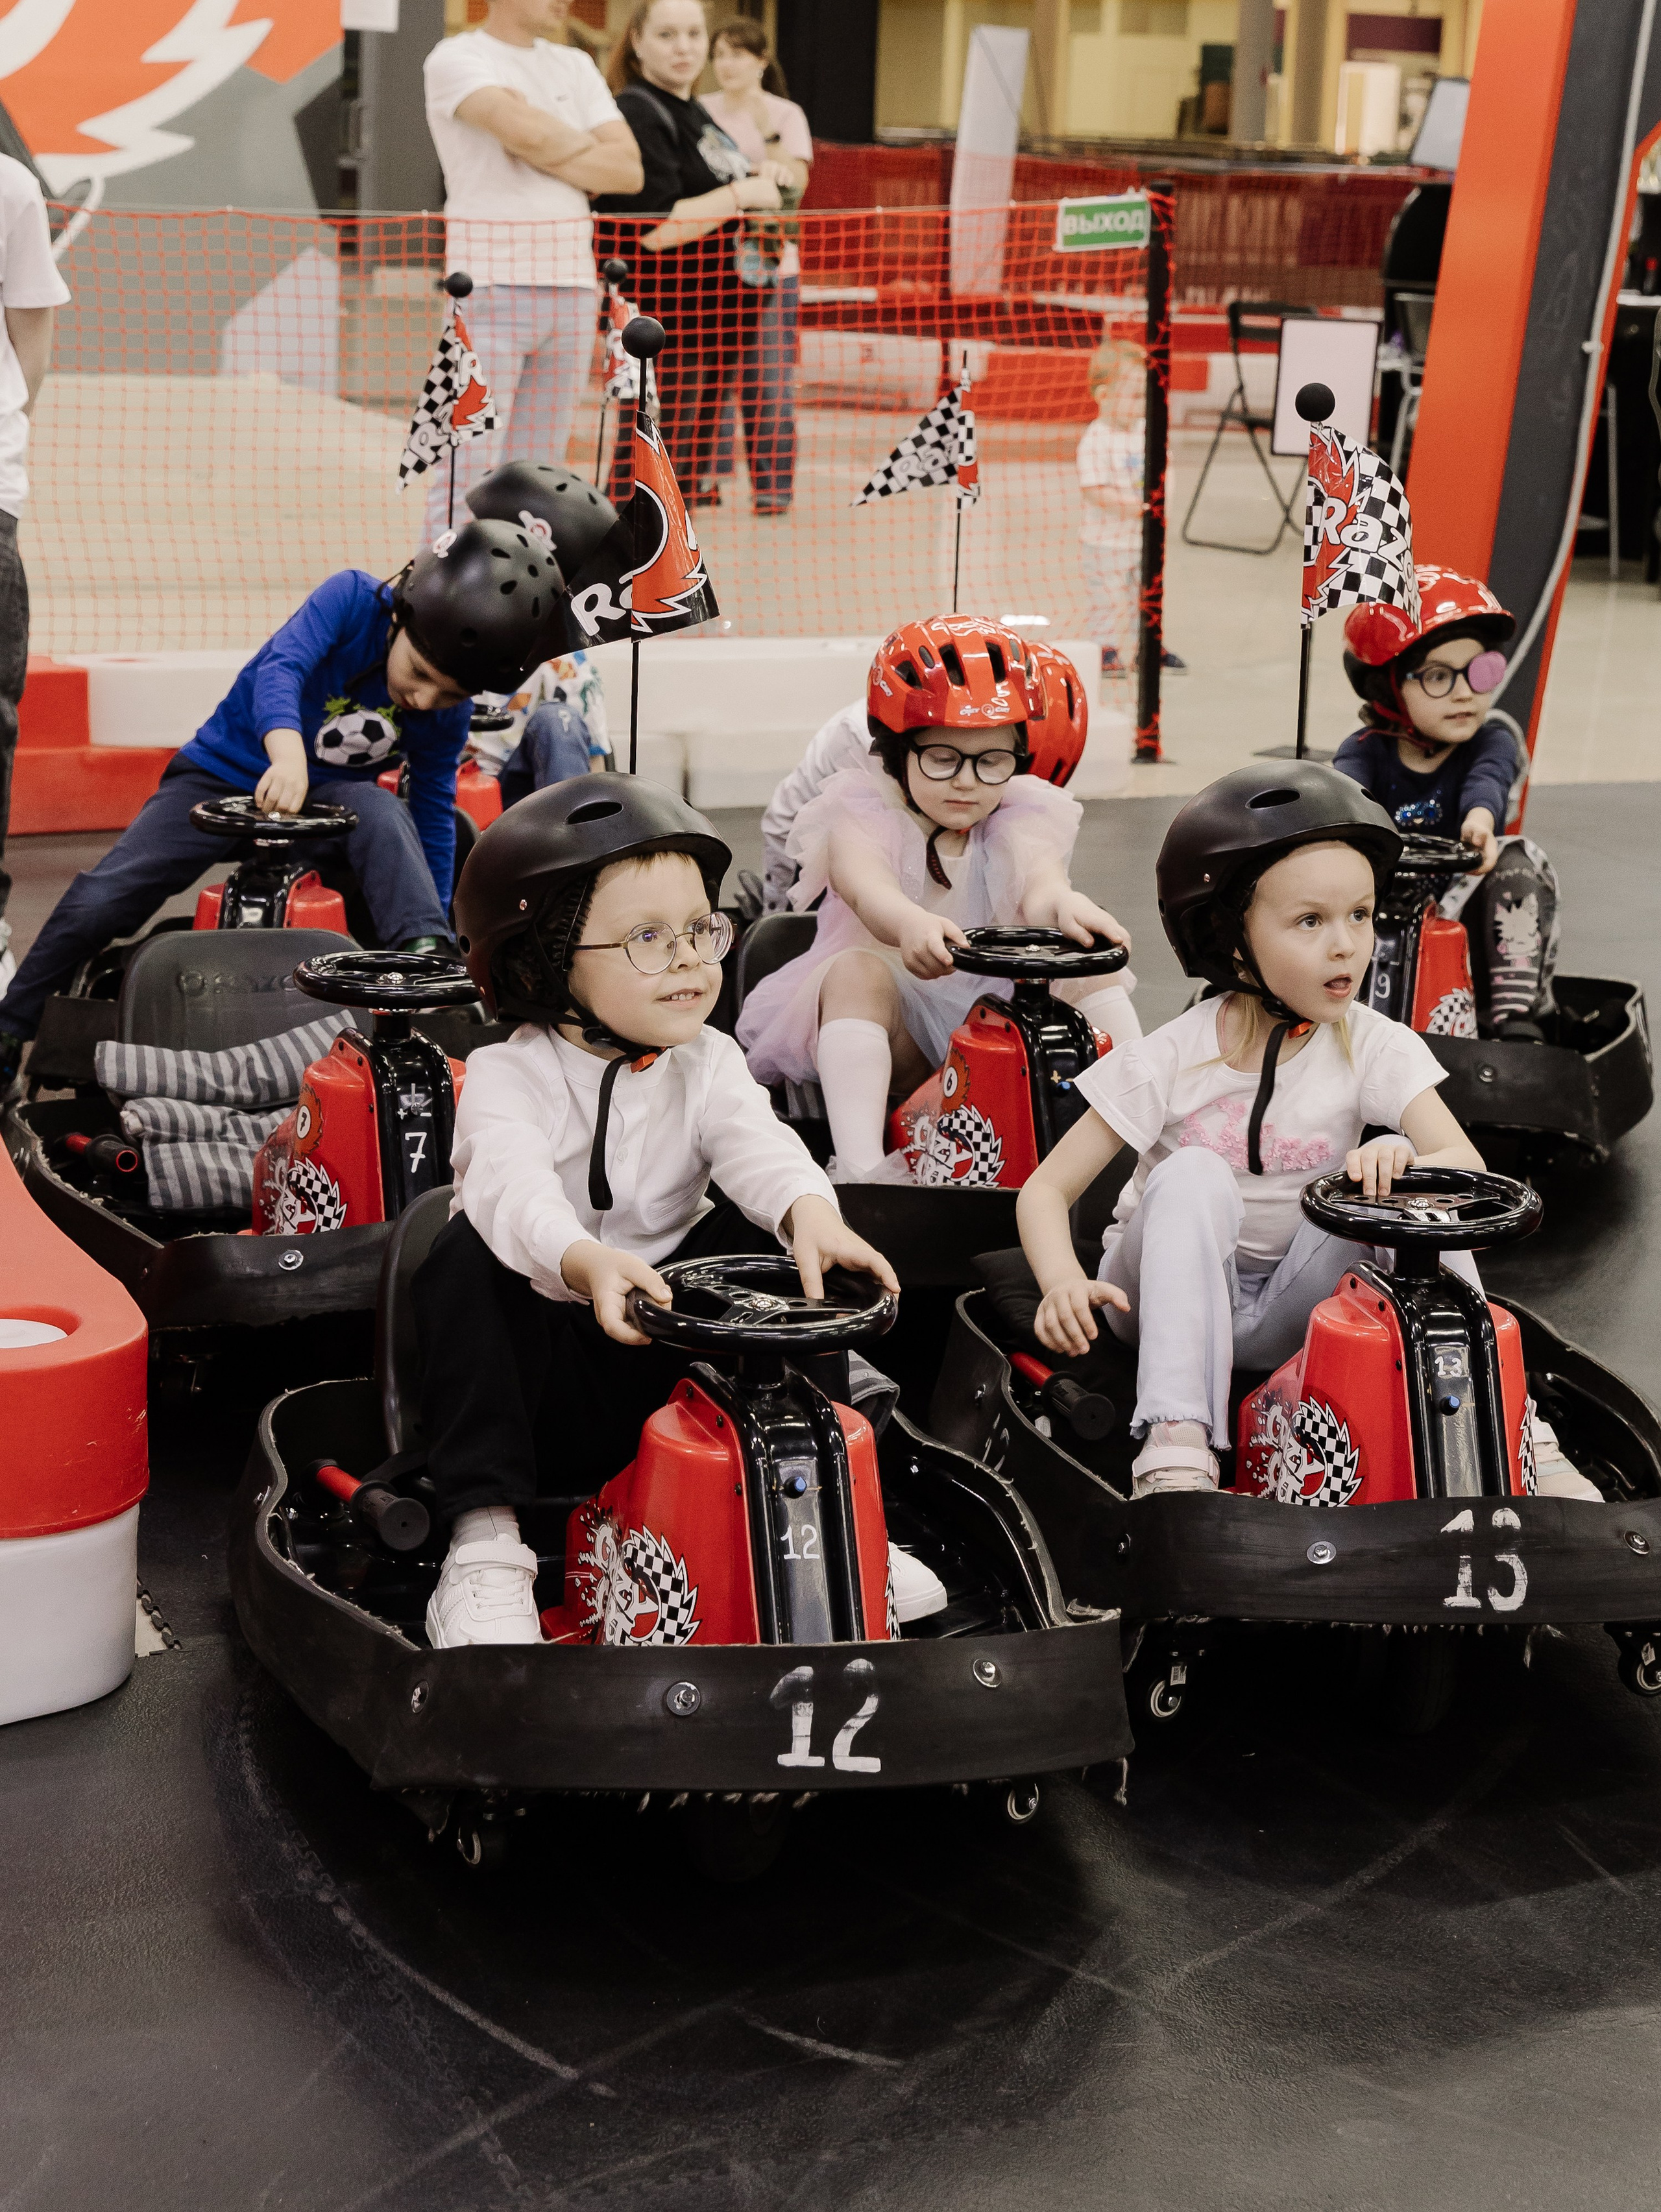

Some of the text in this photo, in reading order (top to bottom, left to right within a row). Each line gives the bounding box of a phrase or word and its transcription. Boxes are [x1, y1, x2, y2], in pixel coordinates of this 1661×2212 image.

[1063, 209, 1145, 235] ВЫХОД
[1374, 972, 1390, 999] 9
[299, 1112, 308, 1133] 7
[404, 1131, 428, 1173] 7
[1434, 1355, 1462, 1378] 13
[781, 1524, 820, 1559] 12
[1440, 1507, 1528, 1612] 13
[768, 1657, 882, 1773] 12
